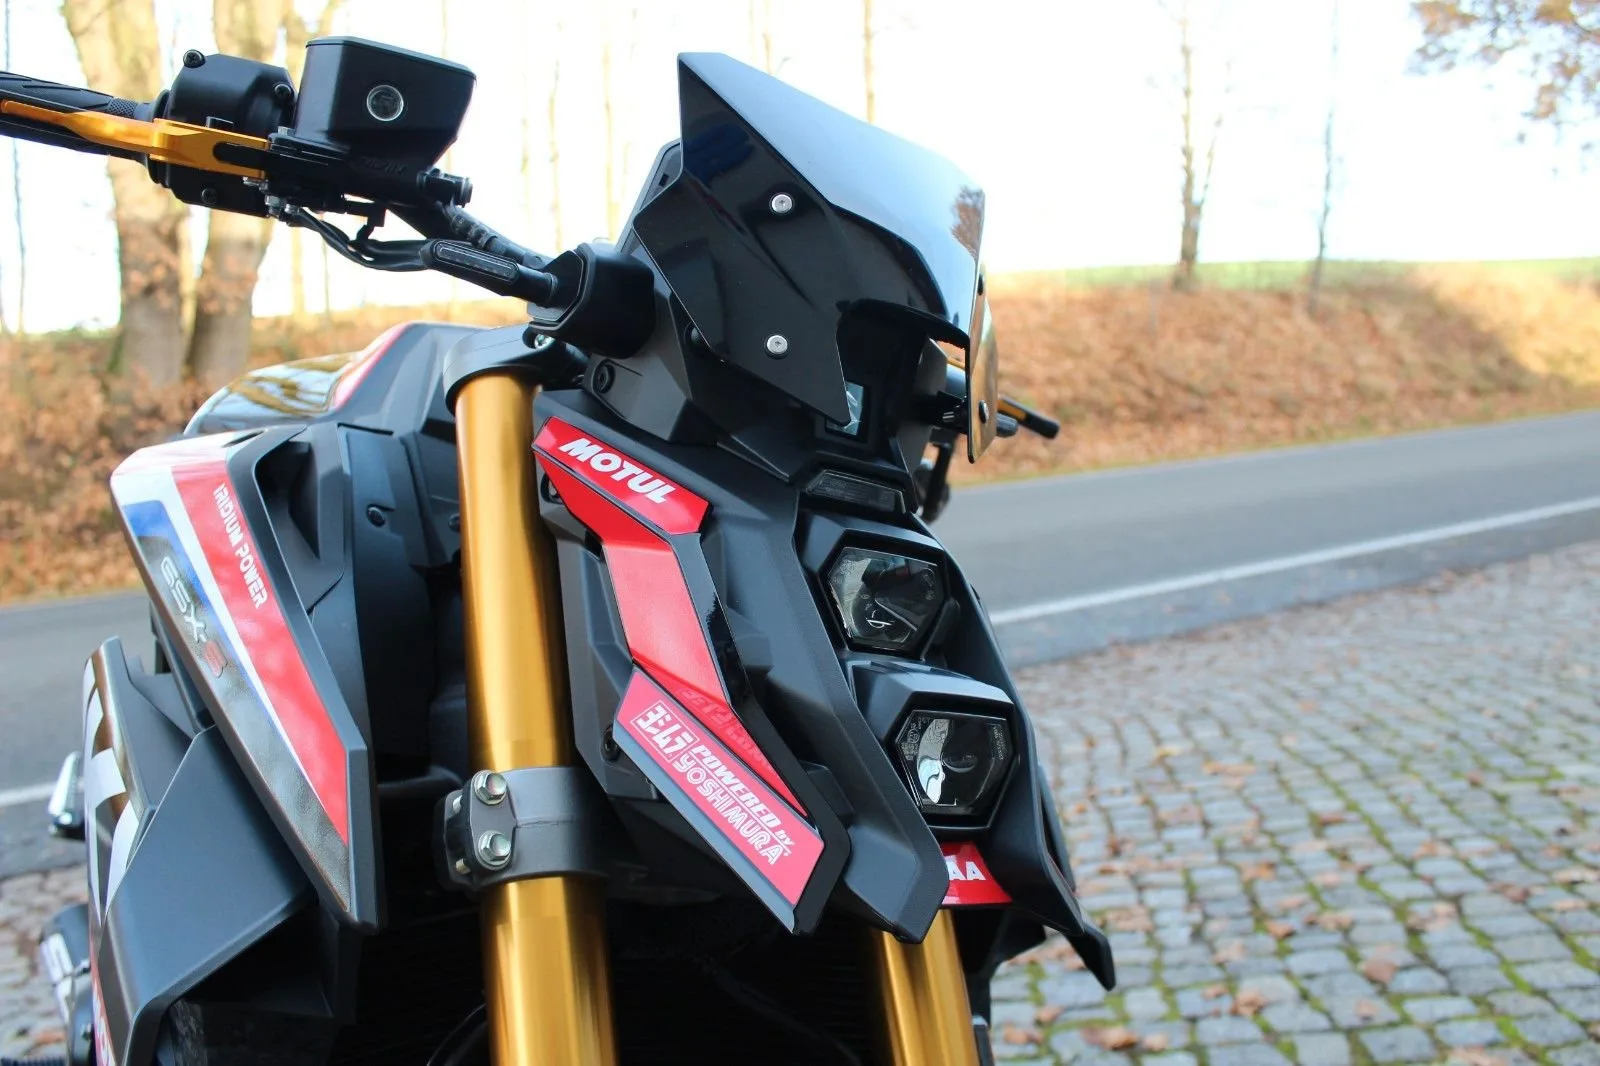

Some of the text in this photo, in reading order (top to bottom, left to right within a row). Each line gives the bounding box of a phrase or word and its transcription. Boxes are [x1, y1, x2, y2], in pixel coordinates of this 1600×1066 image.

[558, 437, 676, 504] MOTUL
[212, 484, 269, 609] IRIDIUM POWER
[160, 555, 228, 679] GSX-S
[671, 753, 785, 866] YOSHIMURA
[689, 744, 782, 829] POWERED
[774, 829, 797, 847] by
